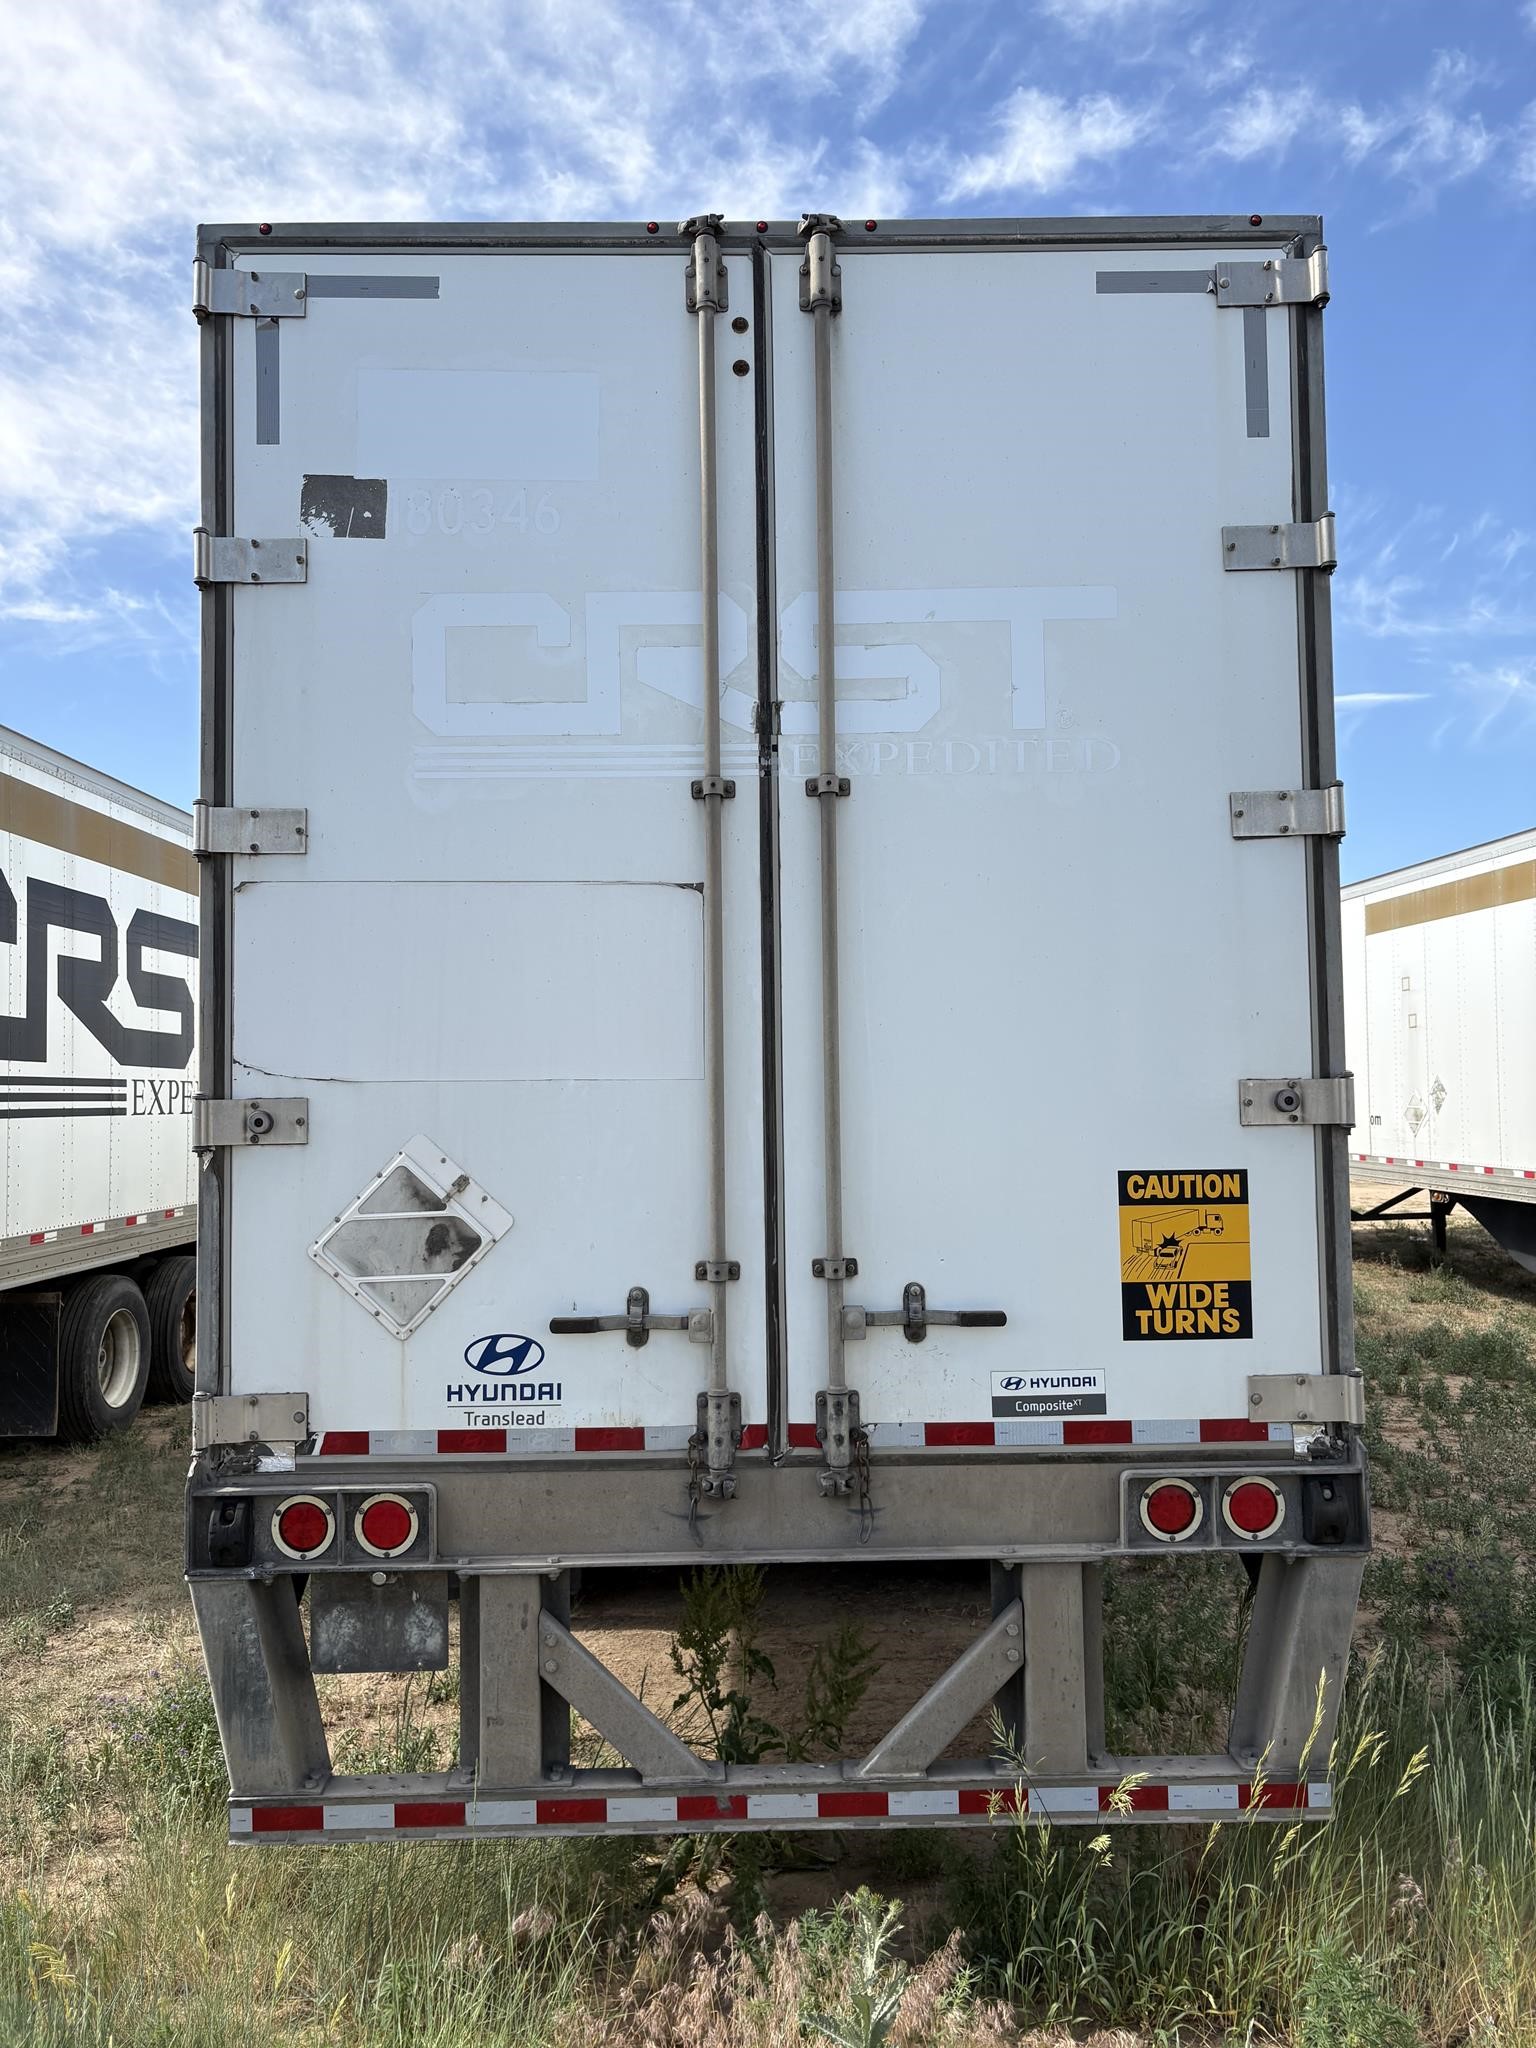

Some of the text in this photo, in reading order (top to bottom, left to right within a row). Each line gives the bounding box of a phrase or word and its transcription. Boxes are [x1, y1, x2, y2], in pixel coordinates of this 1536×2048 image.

[789, 738, 1121, 777] EXPEDITED
[131, 1079, 199, 1116] EXPE
[1126, 1173, 1241, 1200] CAUTION
[1145, 1283, 1230, 1309] WIDE
[1135, 1308, 1241, 1335] TURNS
[447, 1382, 562, 1402] HYUNDAI
[1030, 1376, 1097, 1389] HYUNDAI
[464, 1410, 546, 1427] Translead
